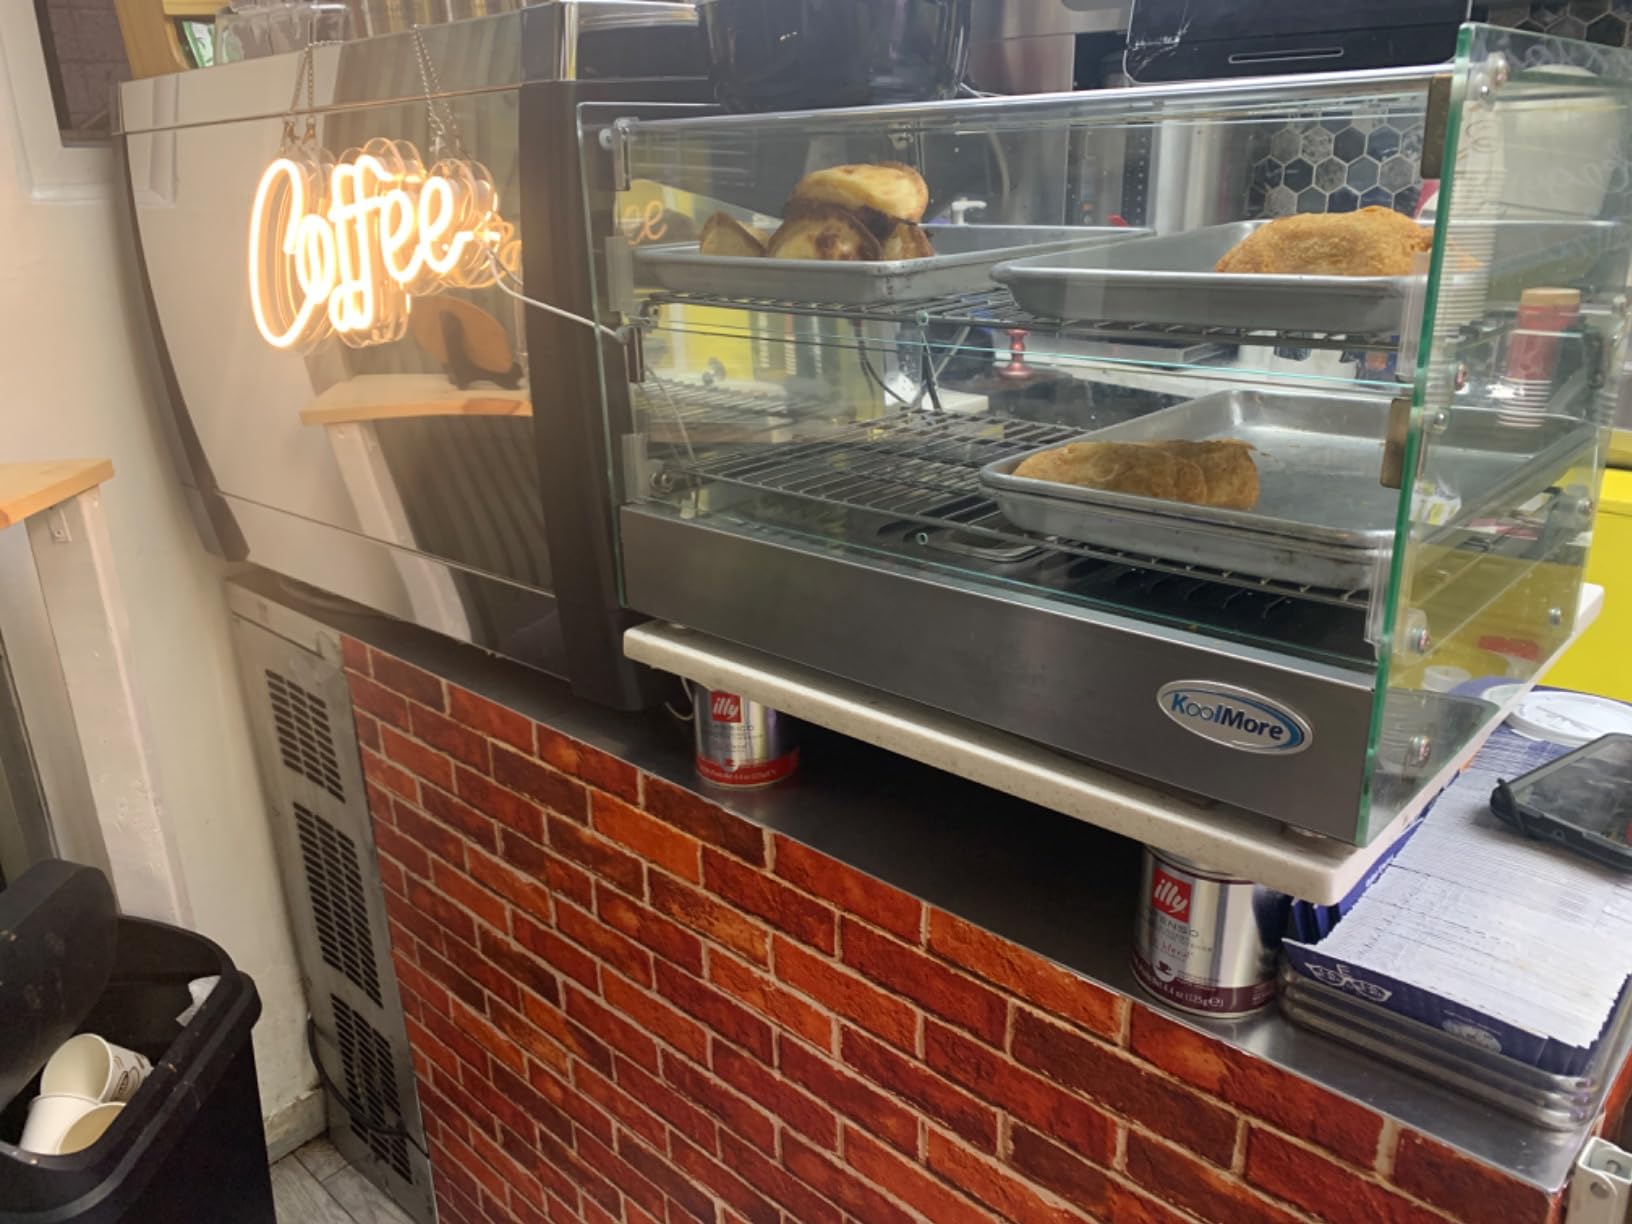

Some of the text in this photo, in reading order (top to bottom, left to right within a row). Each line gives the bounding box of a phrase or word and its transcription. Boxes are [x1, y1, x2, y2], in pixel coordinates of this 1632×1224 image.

[249, 153, 476, 348] Coffee
[712, 697, 739, 719] illy
[1171, 692, 1284, 741] KoolMore
[1153, 878, 1188, 914] illy
